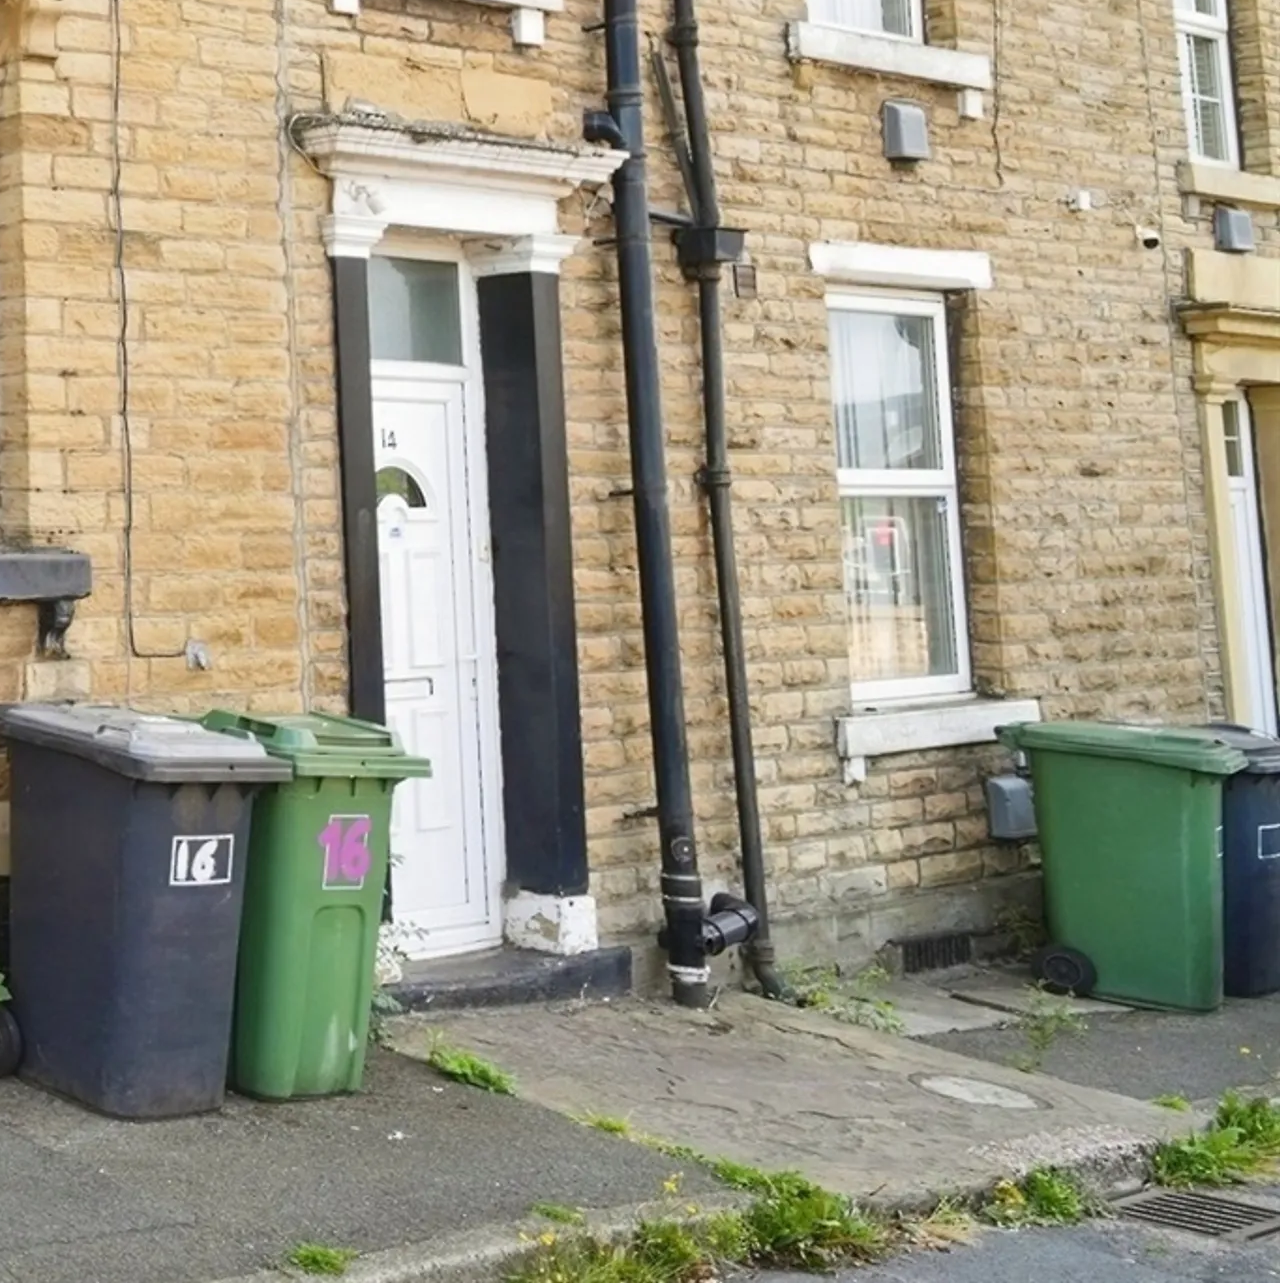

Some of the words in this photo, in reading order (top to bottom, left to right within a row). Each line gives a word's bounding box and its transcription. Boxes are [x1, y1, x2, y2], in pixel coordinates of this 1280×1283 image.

[381, 427, 398, 450] 14
[177, 839, 218, 883] 16
[318, 818, 372, 881] 16
